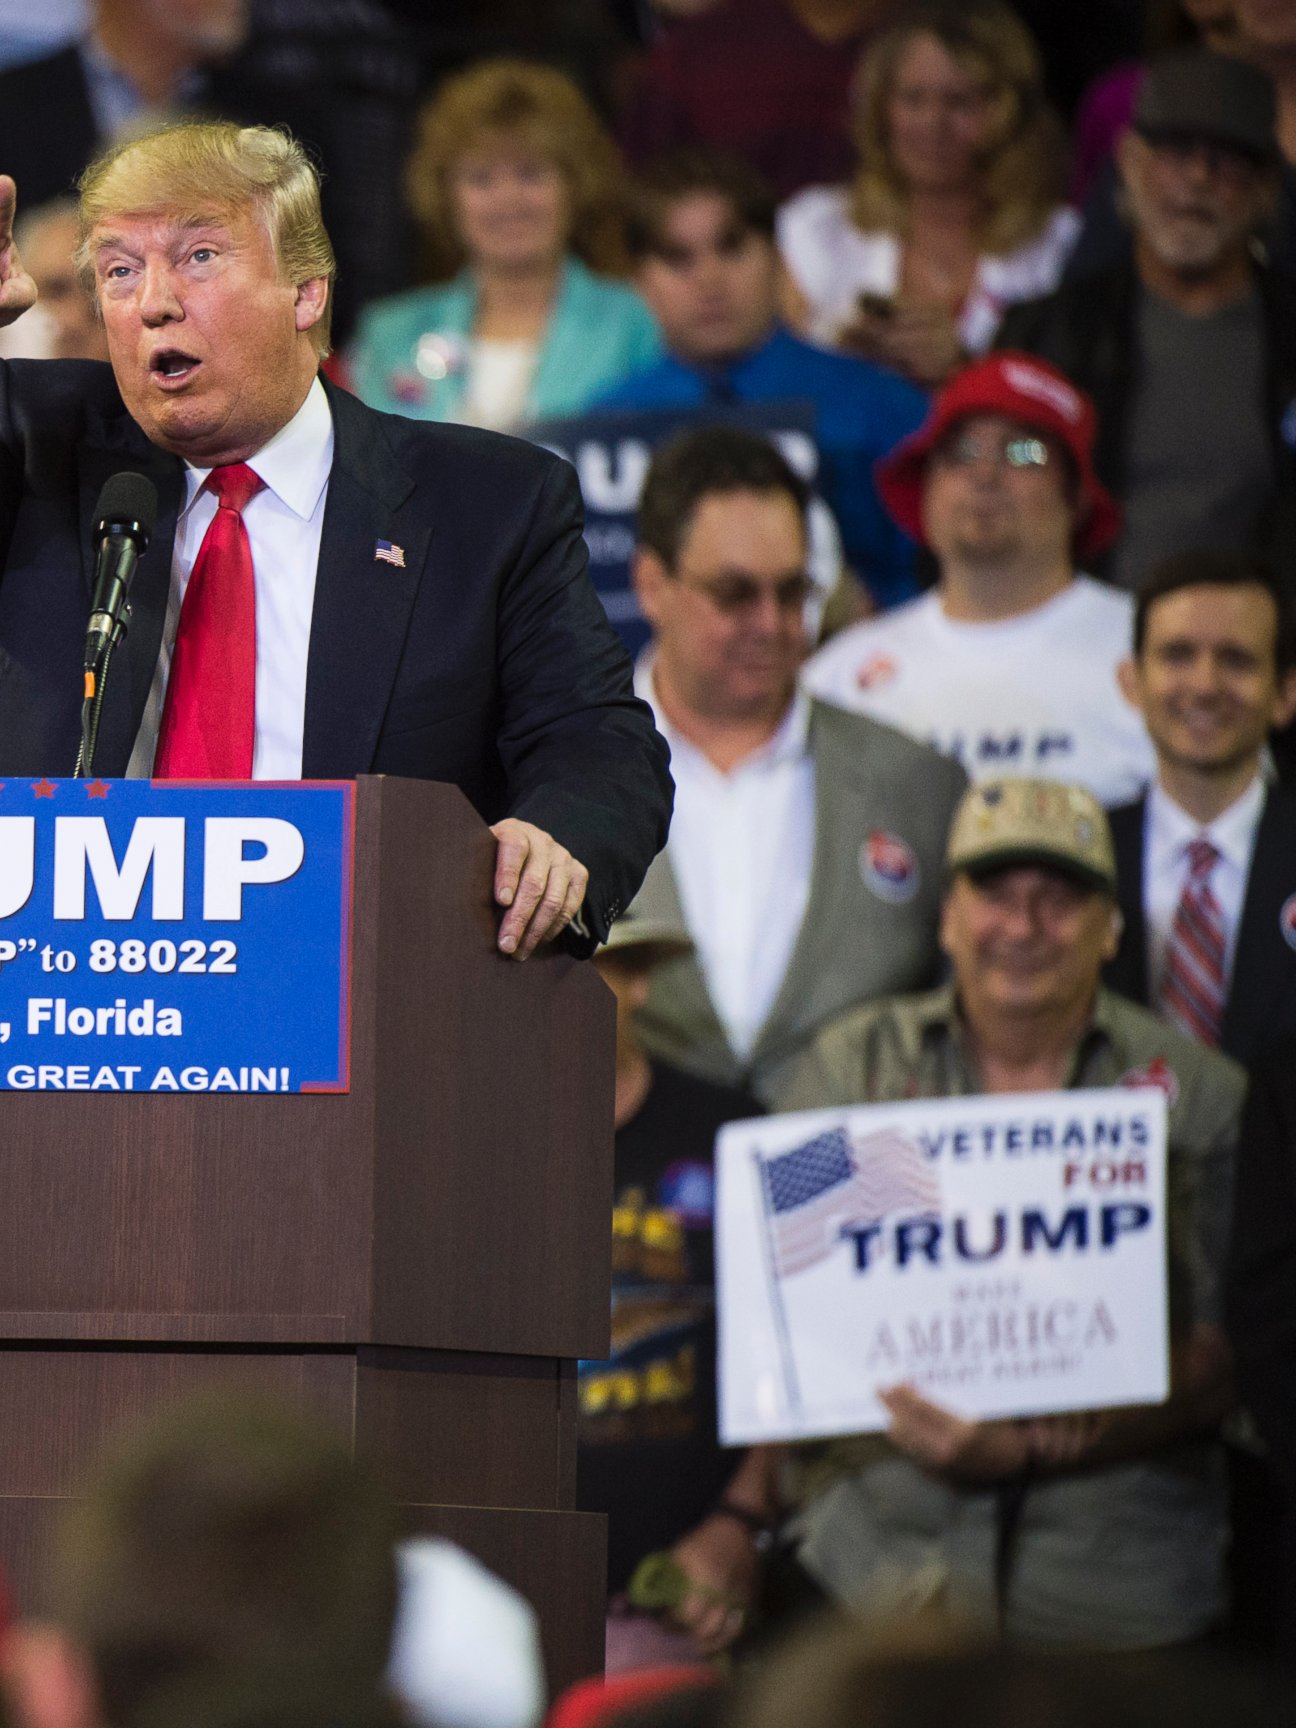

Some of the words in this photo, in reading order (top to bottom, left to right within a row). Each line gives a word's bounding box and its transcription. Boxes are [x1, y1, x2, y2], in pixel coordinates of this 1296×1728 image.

[40, 944, 77, 973] to
[88, 938, 238, 974] 88022
[27, 997, 183, 1037] Florida
[7, 1064, 142, 1090] GREAT
[150, 1066, 290, 1092] AGAIN!
[920, 1112, 1151, 1160] VETERANS
[1062, 1157, 1148, 1190] FOR
[839, 1201, 1153, 1277] TRUMP
[865, 1297, 1119, 1369] AMERICA
